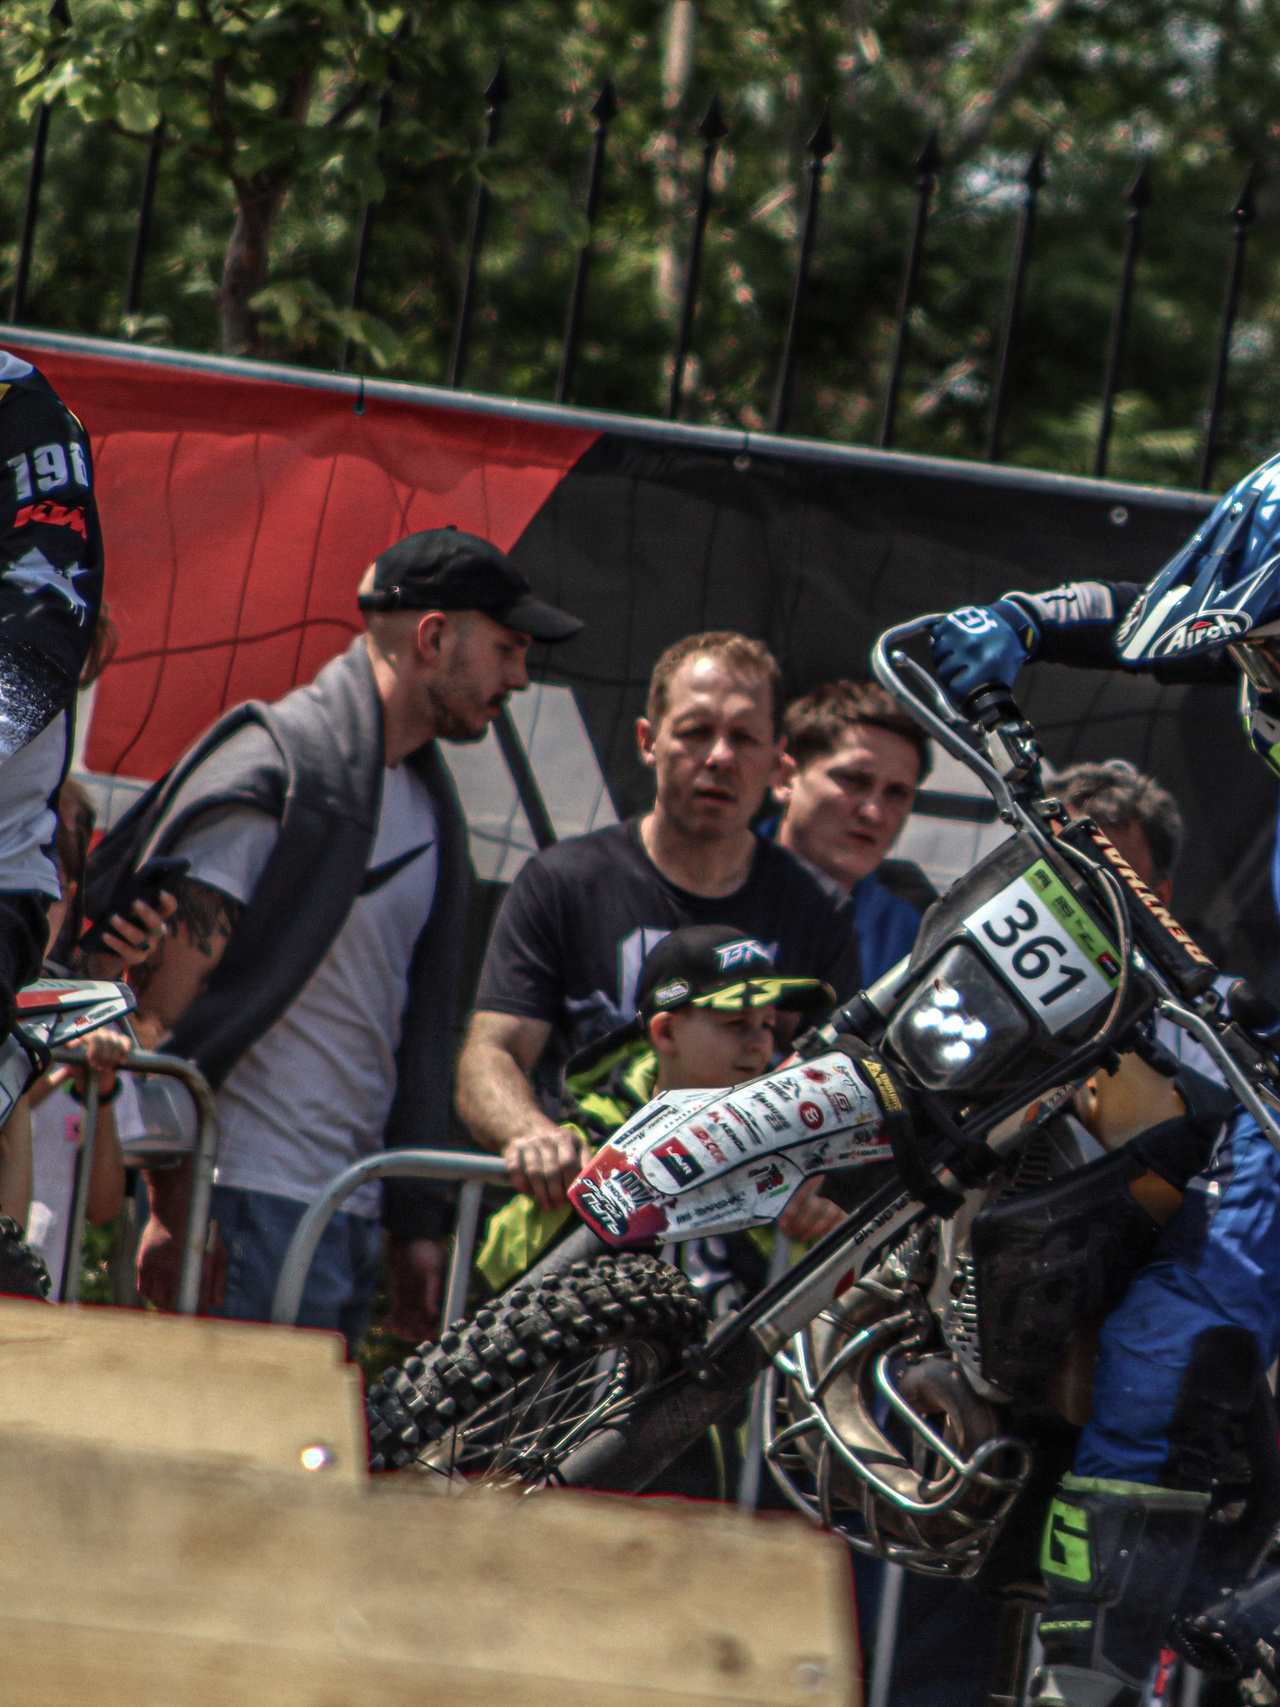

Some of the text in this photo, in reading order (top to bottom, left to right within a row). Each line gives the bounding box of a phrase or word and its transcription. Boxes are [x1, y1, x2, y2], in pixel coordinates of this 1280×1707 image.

[1163, 615, 1242, 655] Airoh
[1090, 825, 1213, 963] RENTHAL
[981, 898, 1087, 1007] 361
[665, 1145, 693, 1176] LAVR
[580, 1192, 623, 1237] ПУТЬ
[602, 1179, 635, 1214] ENDURO
